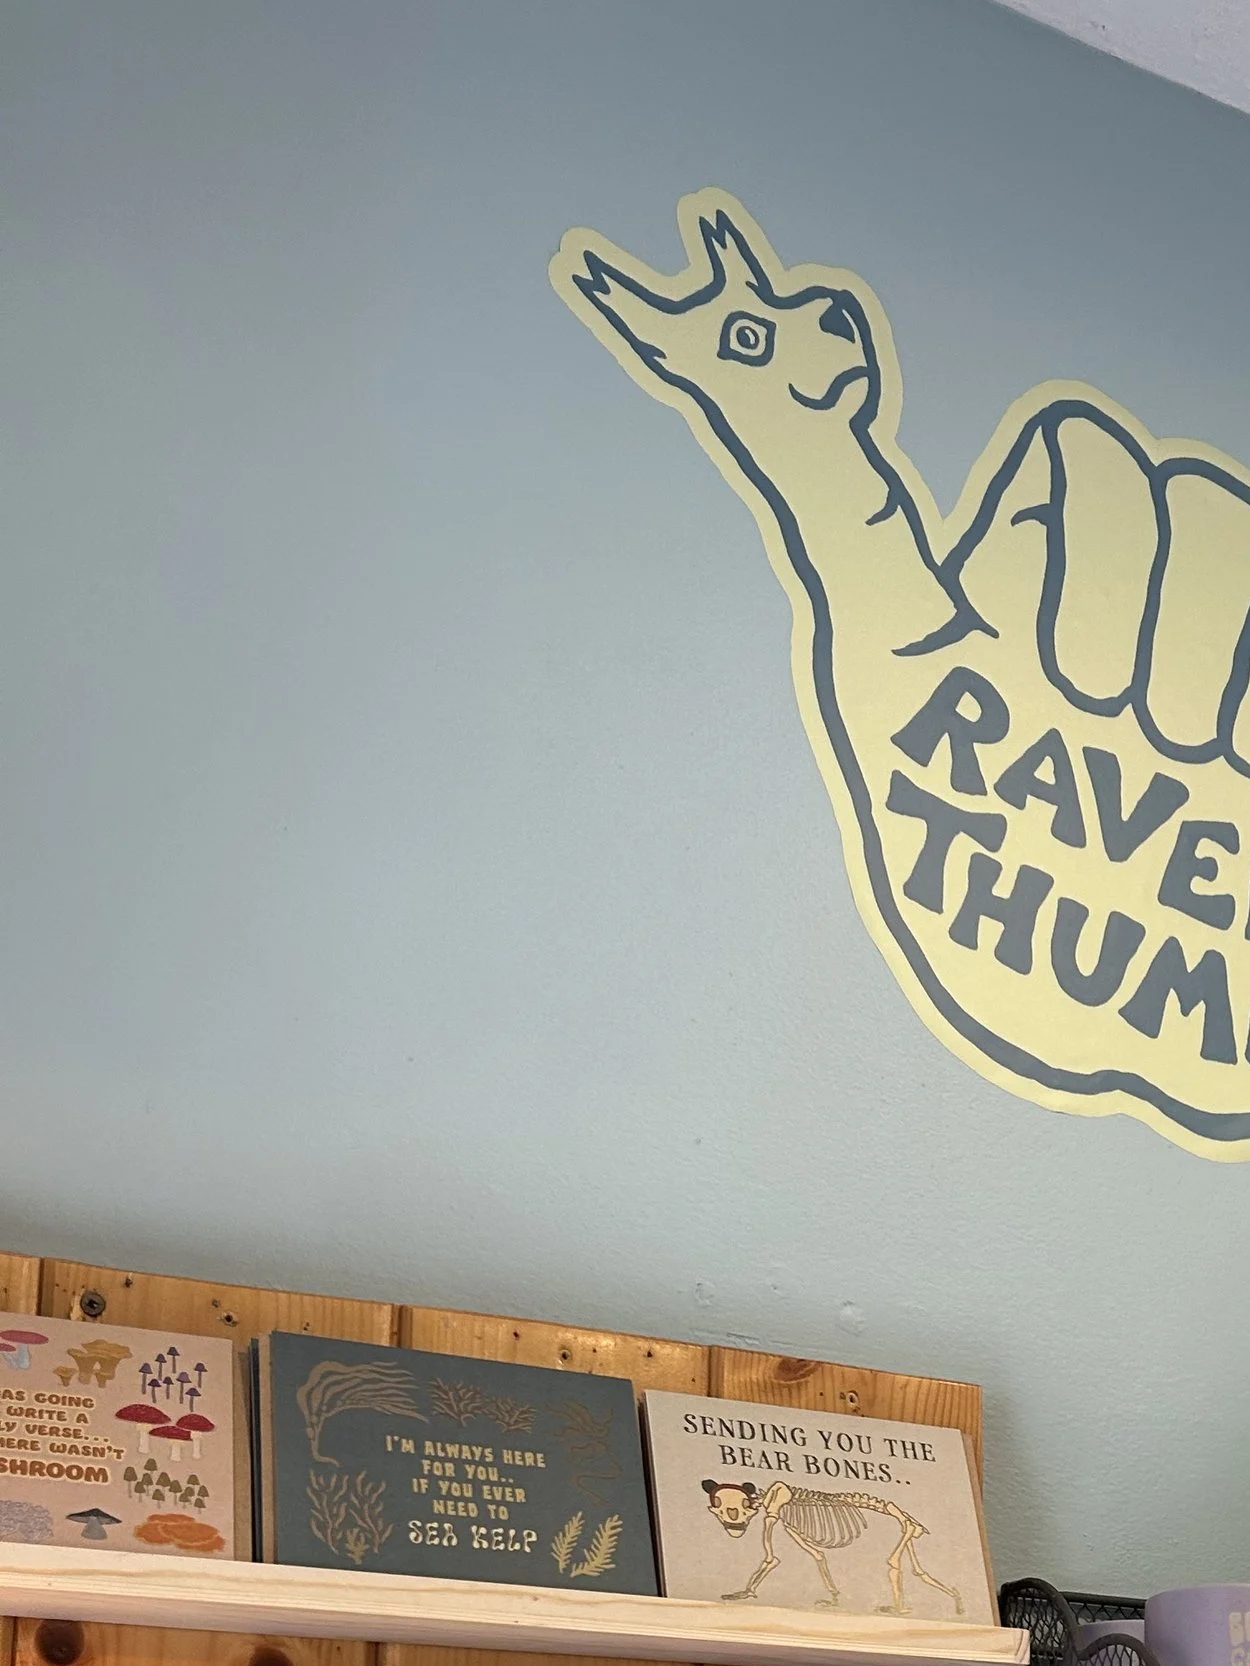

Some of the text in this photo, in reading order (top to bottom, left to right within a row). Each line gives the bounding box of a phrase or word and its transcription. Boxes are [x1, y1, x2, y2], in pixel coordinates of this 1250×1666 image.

[34, 1392, 95, 1408] GOING
[6, 1405, 89, 1424] WRITE A
[683, 1413, 936, 1462] SENDING YOU THE
[49, 1442, 125, 1460] WASN'T
[385, 1435, 546, 1468] I'M ALWAYS HERE
[718, 1444, 794, 1473] BEAR
[421, 1459, 455, 1477] FOR
[412, 1478, 527, 1503] IF YOU EVER
[432, 1499, 509, 1520] NEED TO
[408, 1520, 538, 1553] SEA KELP
